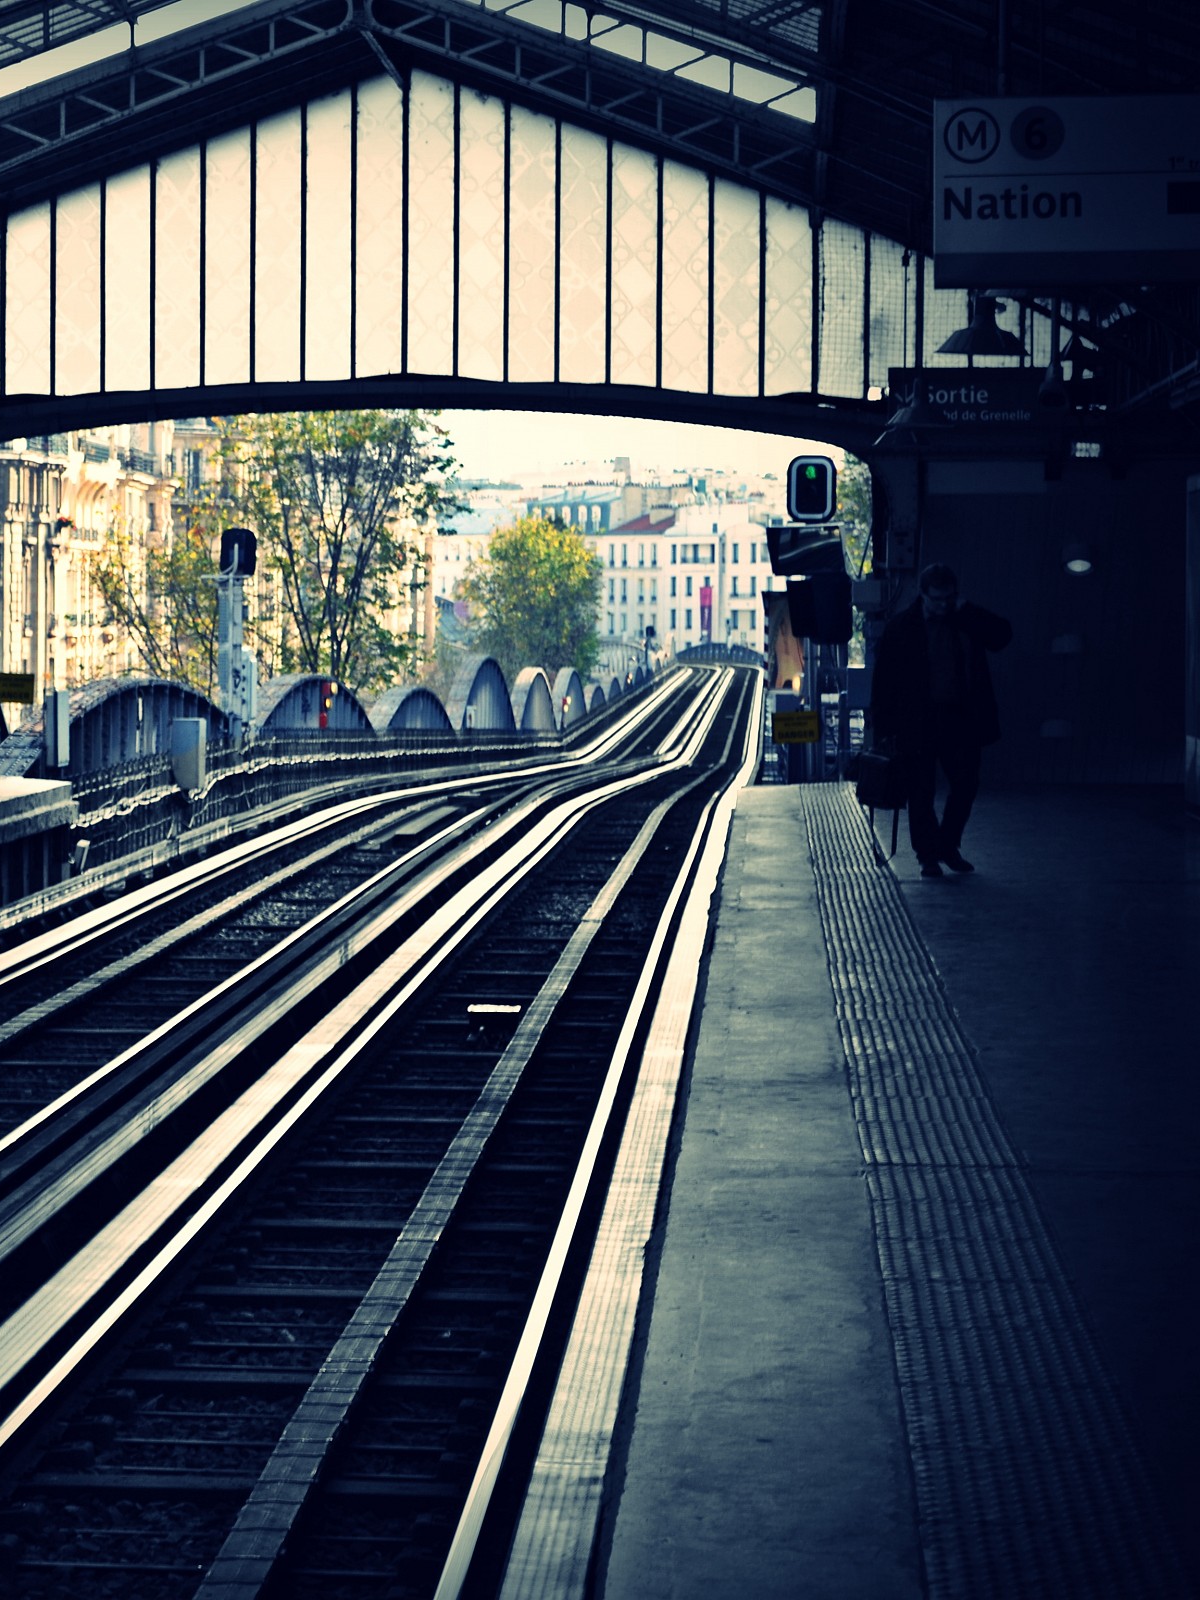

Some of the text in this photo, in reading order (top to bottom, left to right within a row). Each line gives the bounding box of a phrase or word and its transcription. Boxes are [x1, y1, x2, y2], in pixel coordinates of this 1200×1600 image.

[1025, 117, 1048, 150] 6
[943, 184, 1082, 220] Nation
[961, 409, 977, 422] de
[980, 409, 1031, 422] Grenelle
[778, 730, 815, 740] DANGER
